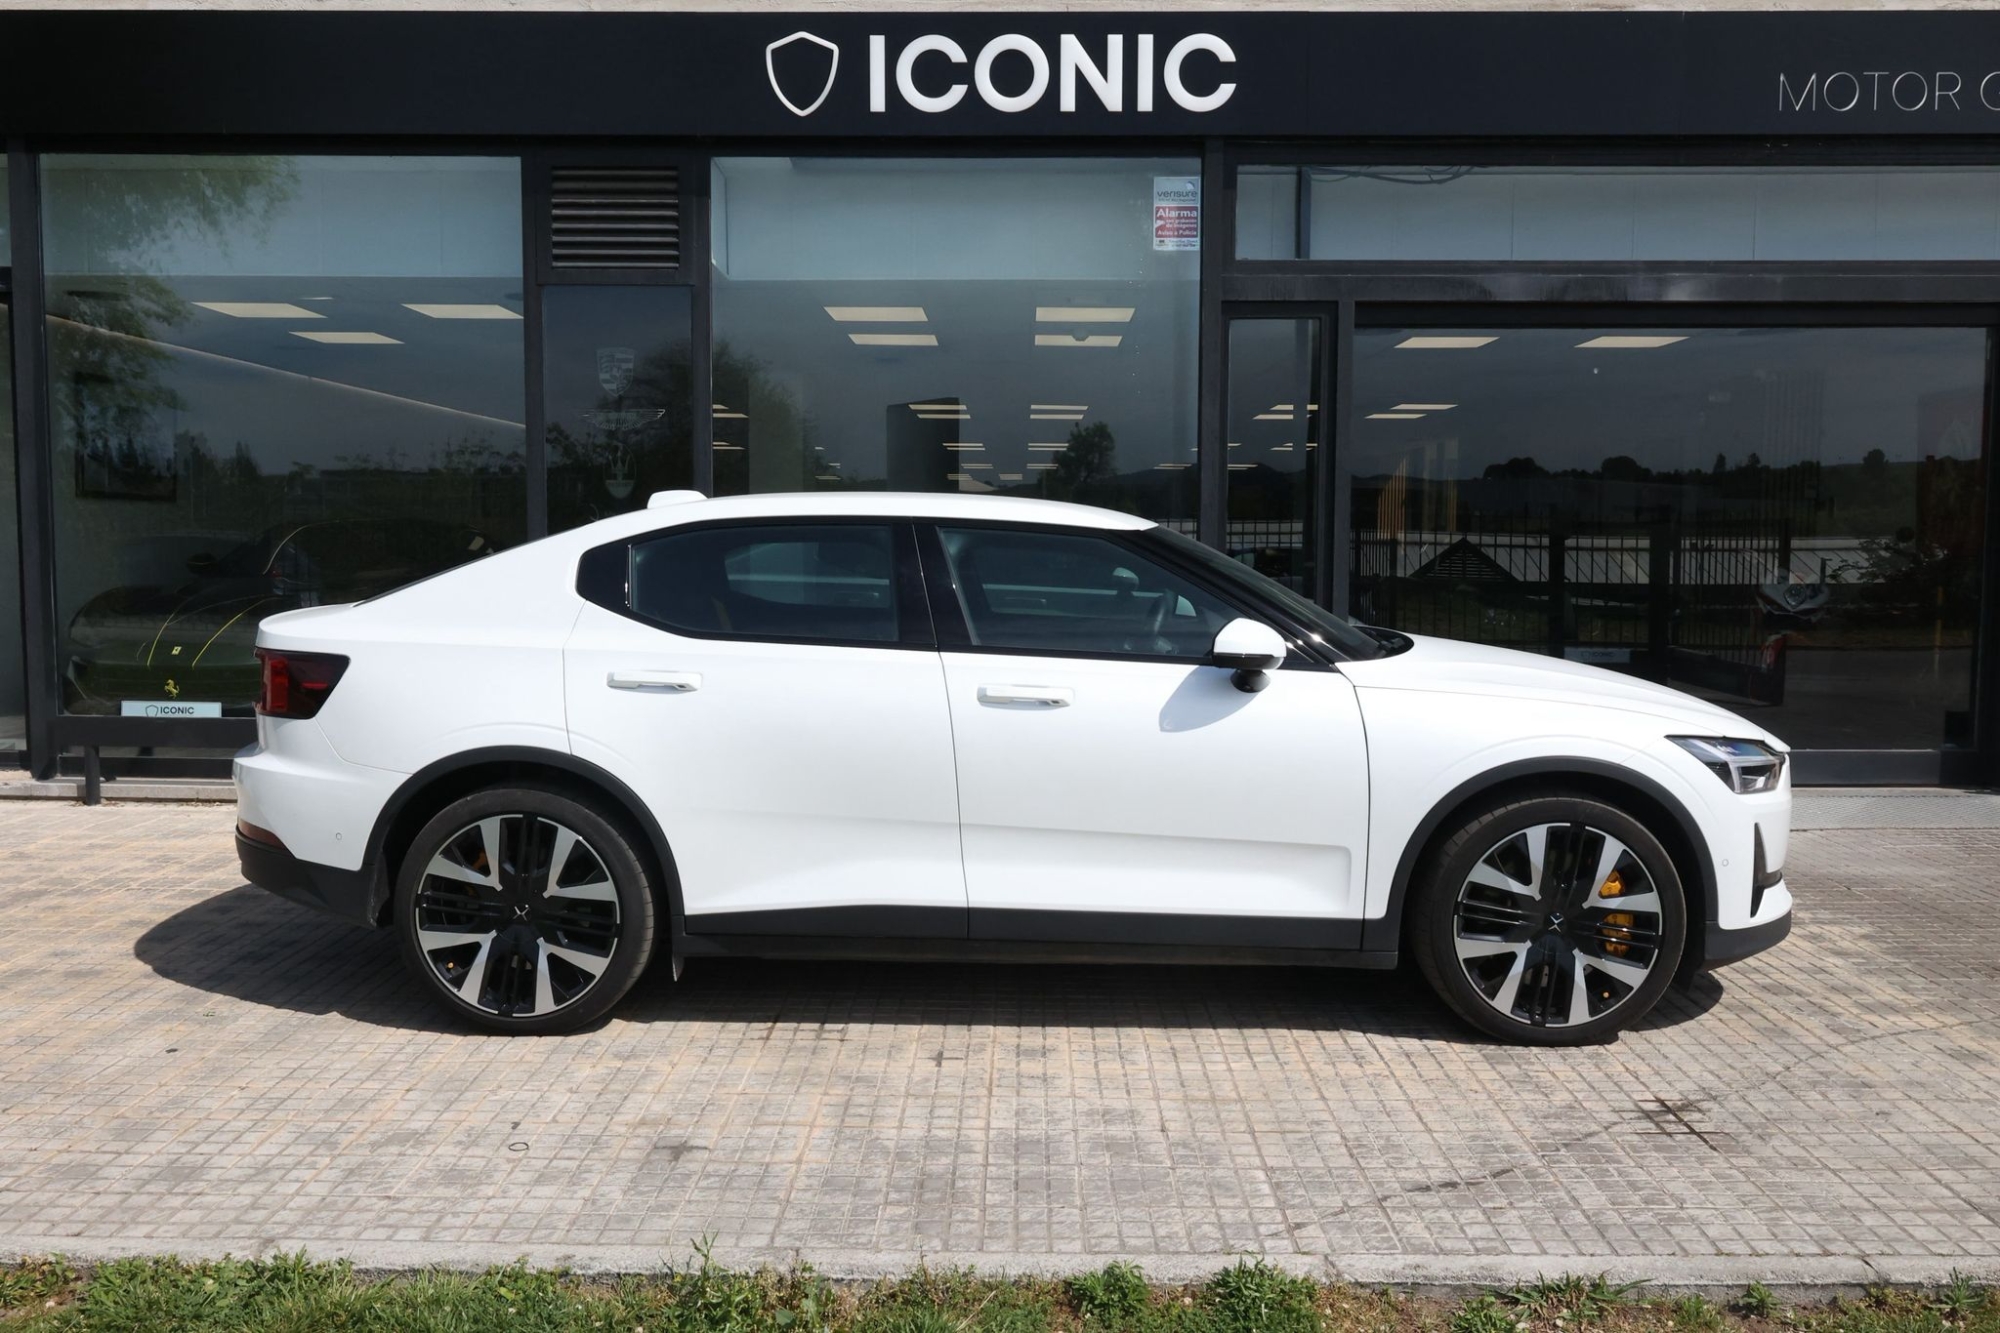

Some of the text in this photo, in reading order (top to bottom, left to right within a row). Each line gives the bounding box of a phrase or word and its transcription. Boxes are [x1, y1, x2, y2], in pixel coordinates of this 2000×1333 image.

[869, 33, 1237, 113] ICONIC
[1779, 71, 1962, 111] MOTOR
[1157, 190, 1198, 198] verisure
[1156, 208, 1197, 217] Alarma
[160, 706, 194, 714] ICONIC
